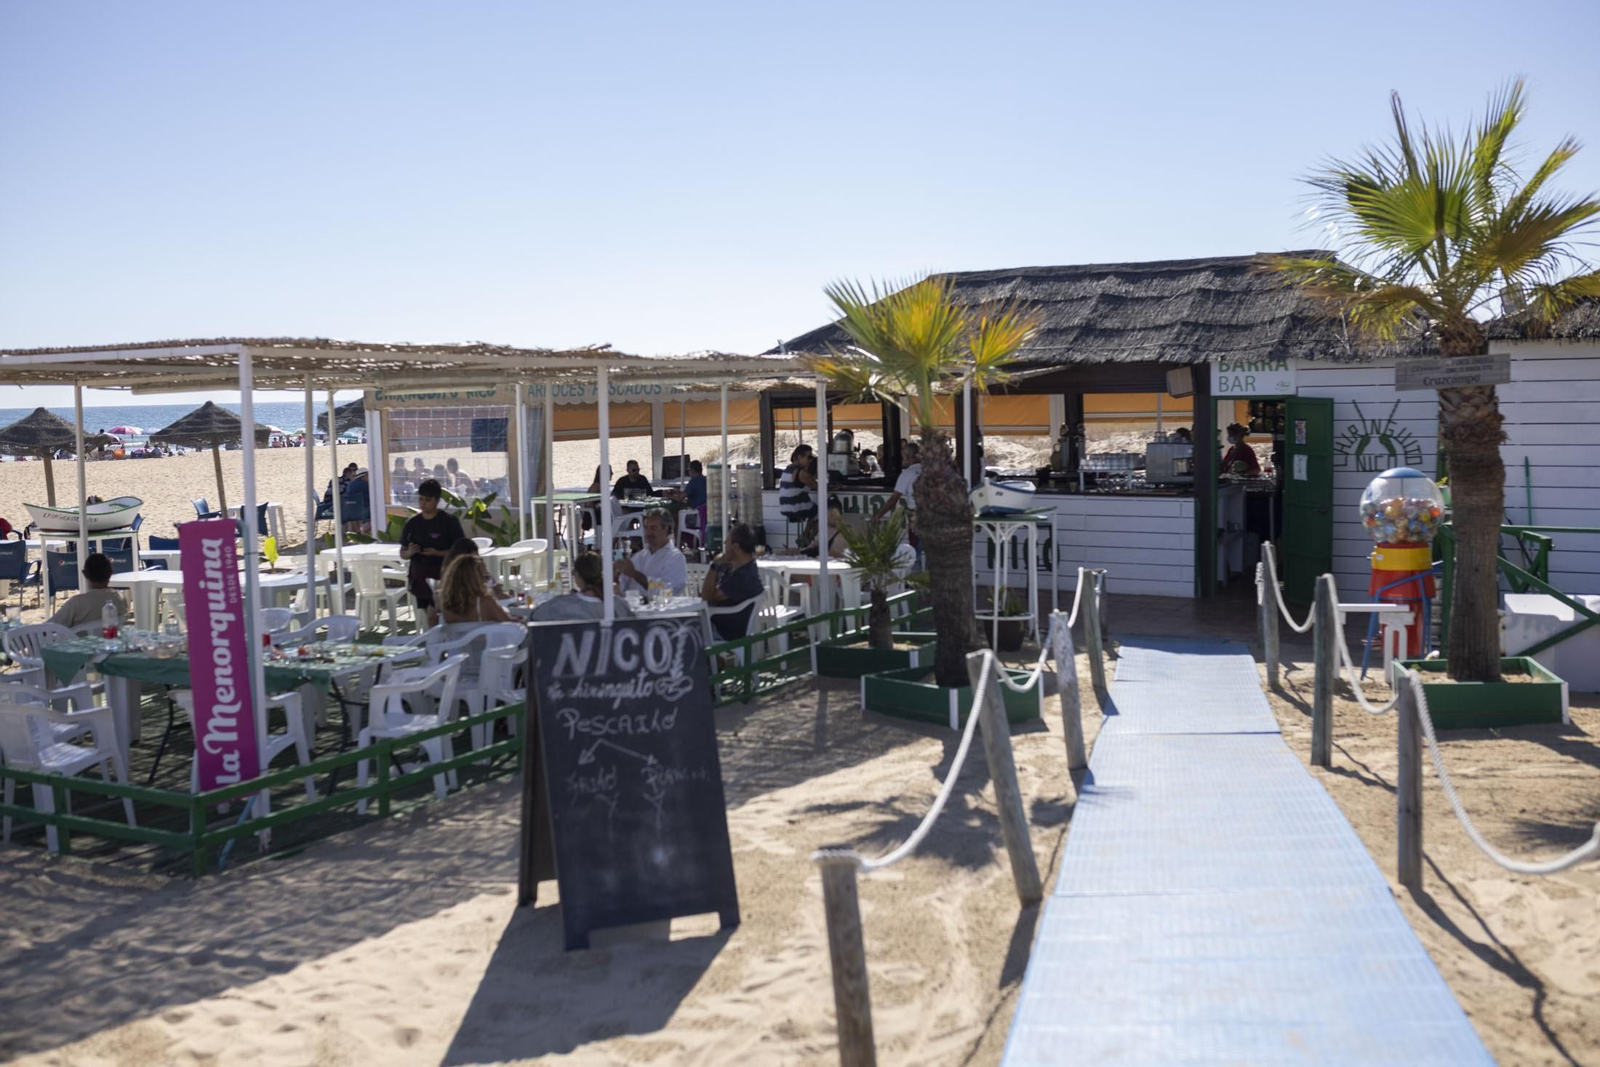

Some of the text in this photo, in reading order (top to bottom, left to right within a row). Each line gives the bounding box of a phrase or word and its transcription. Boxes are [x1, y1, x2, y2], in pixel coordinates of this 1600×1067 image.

[1218, 360, 1289, 372] BARRA
[1219, 375, 1256, 392] BAR
[1423, 374, 1481, 386] Cruzcampo
[592, 383, 662, 396] PSCADOS
[224, 545, 237, 605] DESDE 1940
[199, 537, 243, 755] Menorquina
[552, 626, 672, 676] NICO
